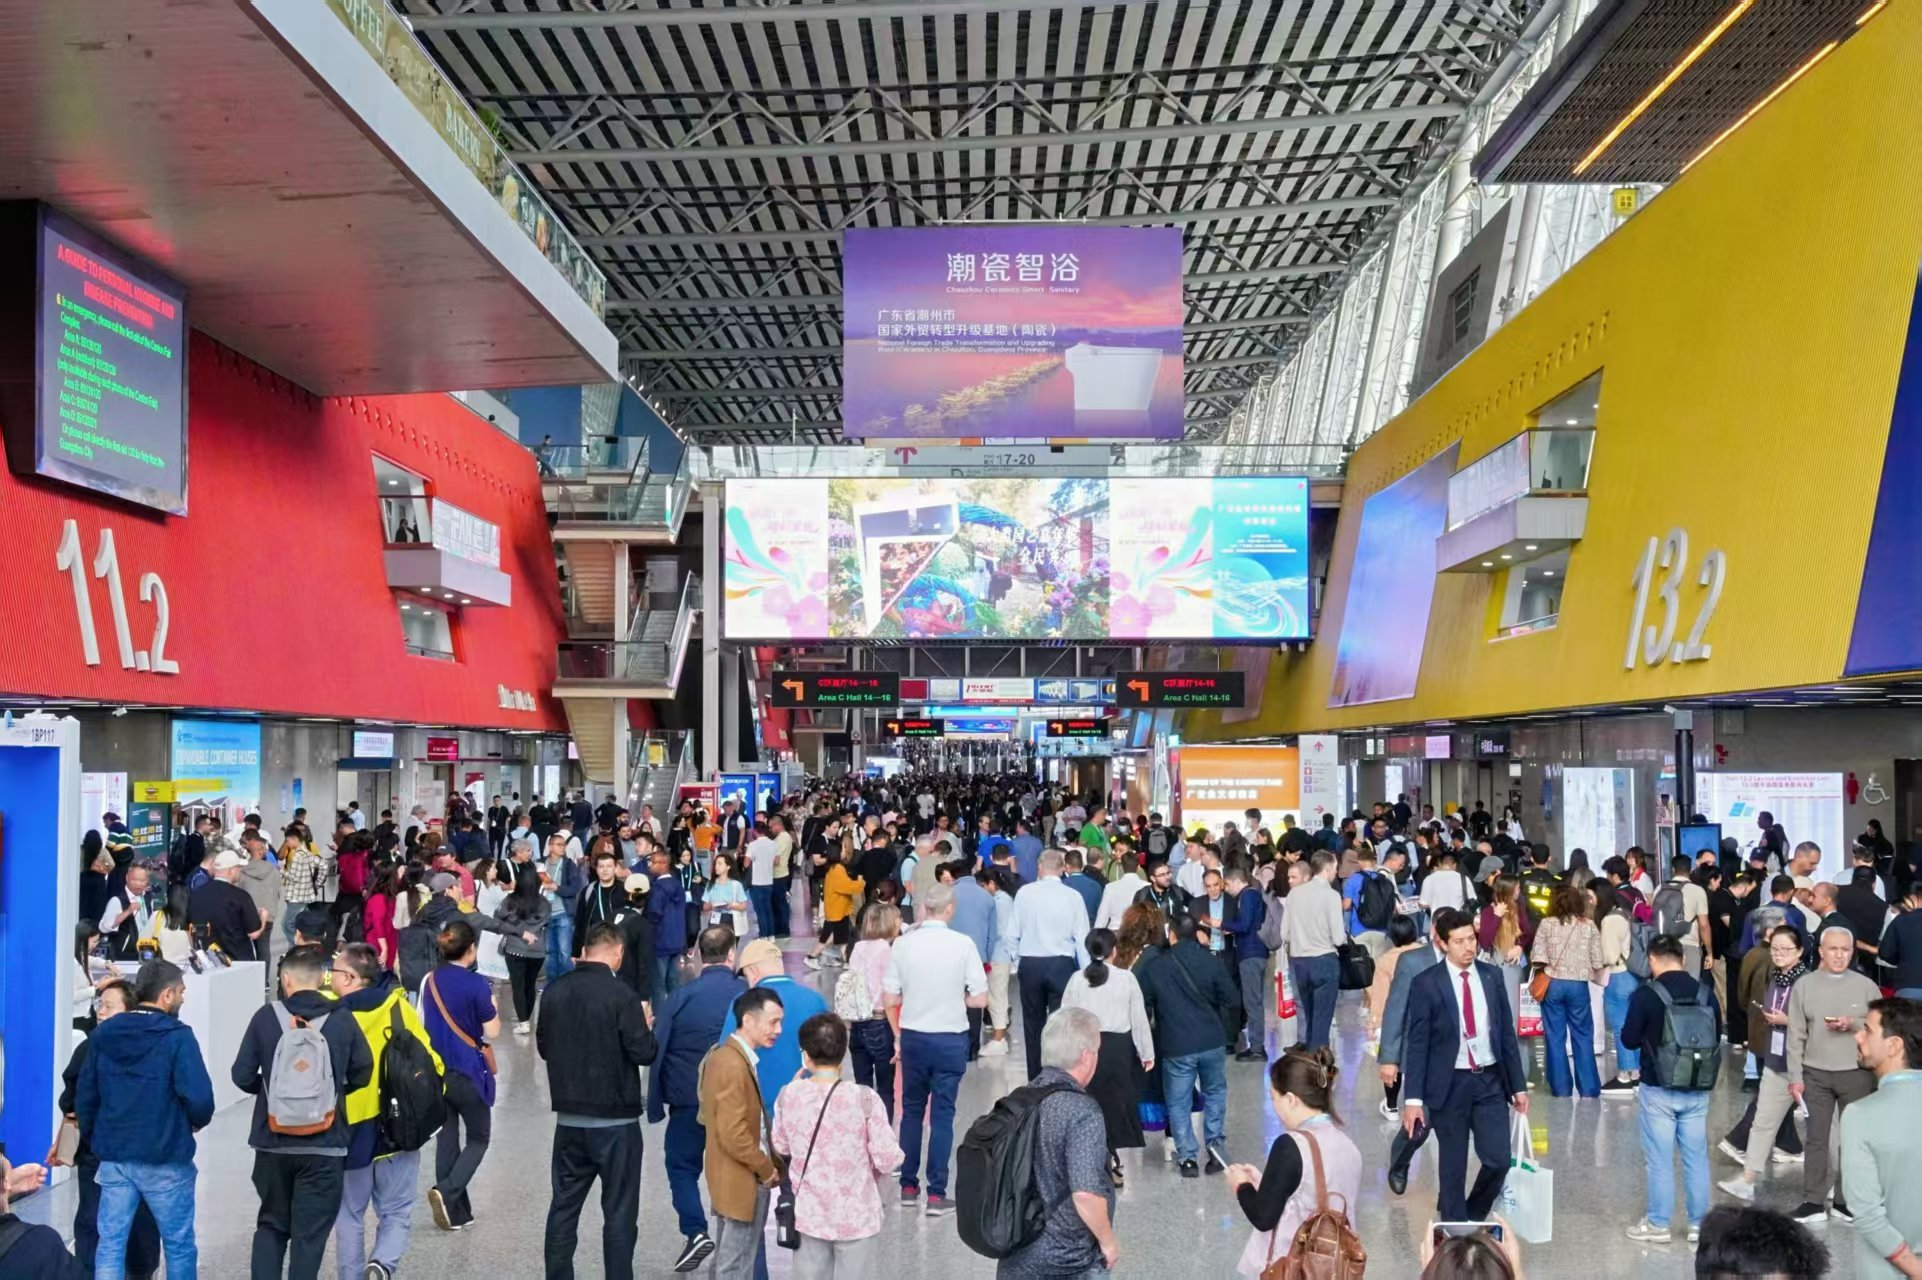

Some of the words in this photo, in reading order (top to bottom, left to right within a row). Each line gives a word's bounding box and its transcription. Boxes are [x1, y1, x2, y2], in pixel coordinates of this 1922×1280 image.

[446, 100, 481, 166] BAKERY
[57, 242, 63, 260] A
[87, 258, 97, 279] TO
[947, 252, 1080, 282] 潮瓷智浴
[946, 286, 983, 294] Chaozhou
[985, 286, 1020, 294] Ceramics
[1022, 286, 1045, 294] Smart
[1049, 286, 1080, 295] Sanitary
[877, 309, 956, 322] 广东省潮州市
[877, 324, 1057, 337] 国家外贸转型升级基地（陶瓷）
[906, 340, 932, 348] Foreign
[1021, 340, 1055, 348] Upgrading
[56, 518, 180, 674] 11.2
[1624, 527, 1726, 671] 13.2
